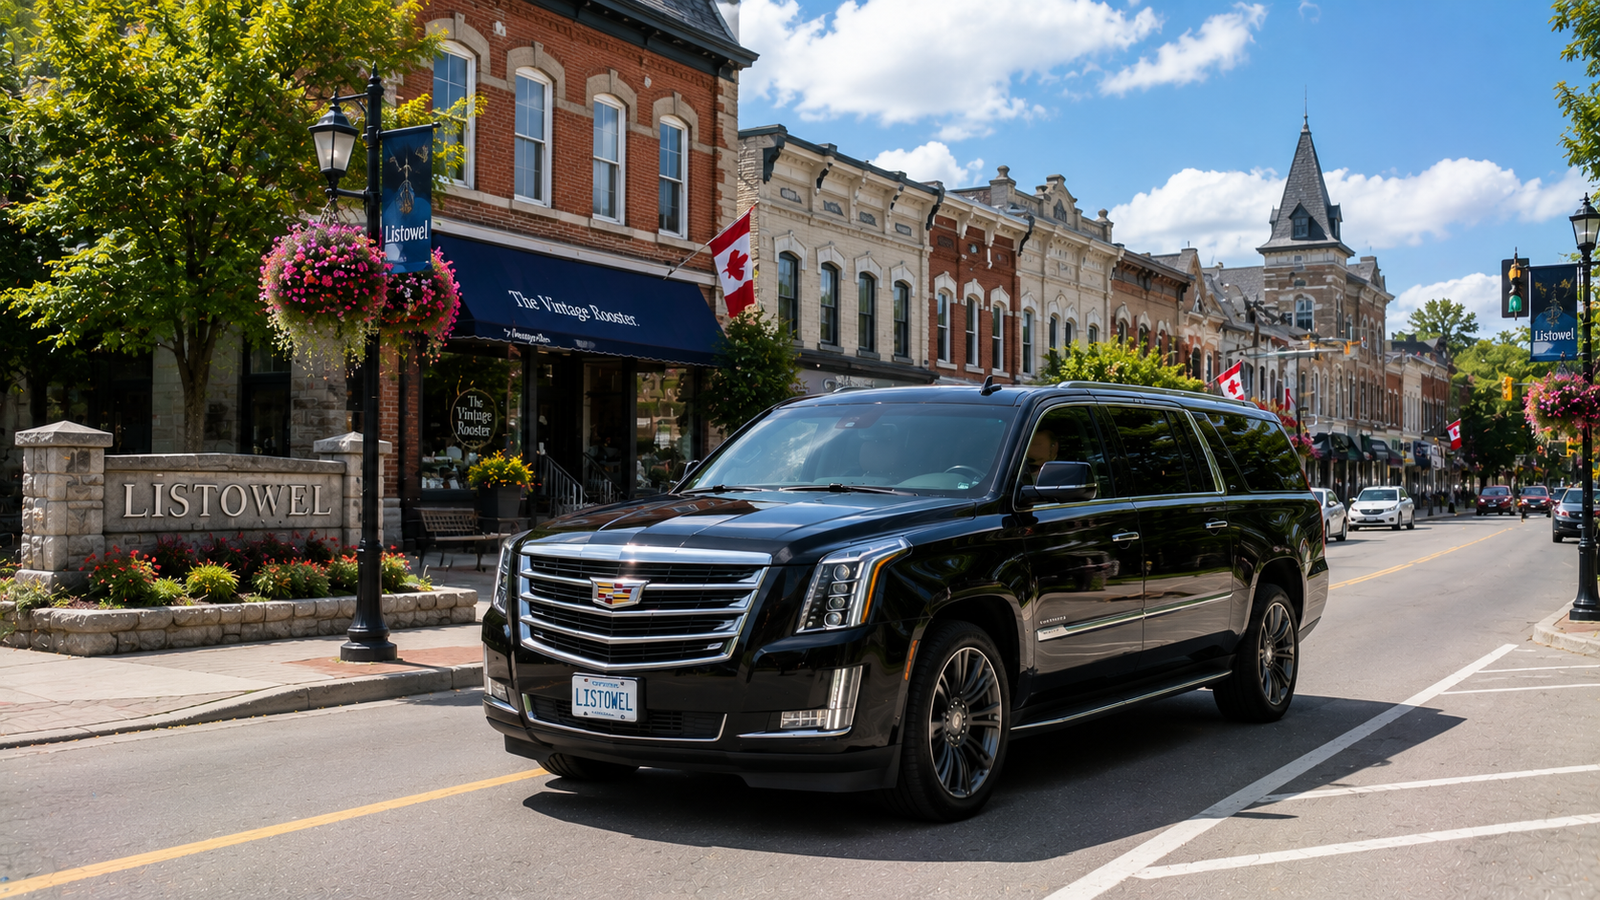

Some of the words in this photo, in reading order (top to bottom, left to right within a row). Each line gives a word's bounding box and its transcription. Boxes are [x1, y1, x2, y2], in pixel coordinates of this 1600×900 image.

[385, 220, 428, 243] Listowel
[508, 289, 540, 310] The
[537, 295, 591, 322] Vintage
[1534, 327, 1575, 342] Listowel
[467, 395, 483, 408] The
[457, 420, 491, 437] Rooster
[123, 483, 332, 518] LISTOWEL
[575, 687, 633, 712] LISTOWEL
